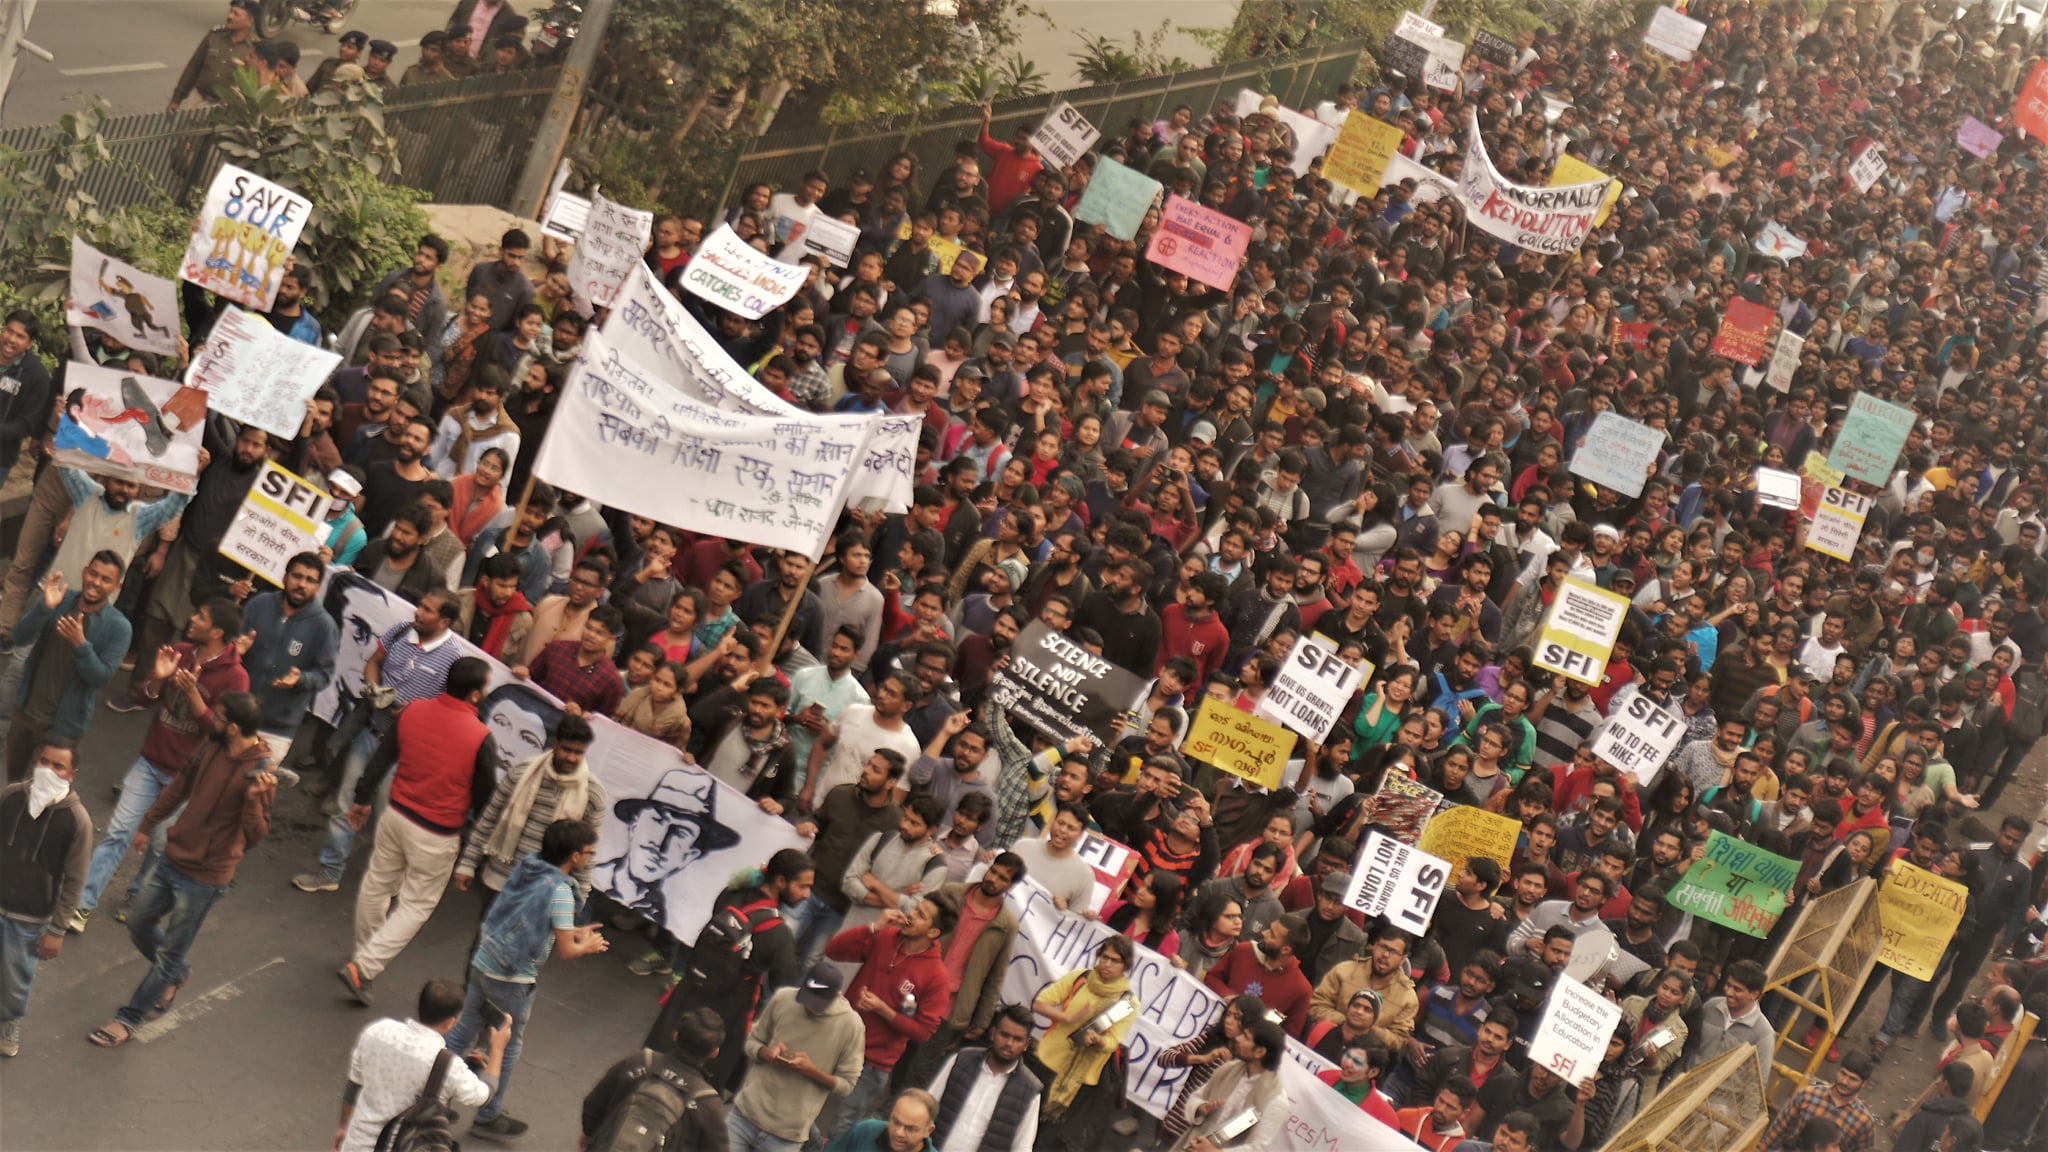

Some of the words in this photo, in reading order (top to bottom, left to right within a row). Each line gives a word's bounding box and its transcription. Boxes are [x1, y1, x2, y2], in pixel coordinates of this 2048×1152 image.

[1035, 130, 1052, 146] NOT
[1060, 107, 1095, 142] SFI
[1866, 149, 1884, 171] SFI
[229, 176, 303, 223] SAVE
[224, 197, 288, 238] OUR
[1194, 222, 1222, 240] EQUAL
[1204, 215, 1240, 233] ACTION
[1188, 244, 1236, 271] REACTION
[689, 268, 744, 302] CATCHES
[752, 272, 788, 297] INDIA
[262, 470, 323, 519] SFI
[1826, 487, 1867, 513] SFI
[1040, 631, 1113, 679] SCIENCE
[1298, 644, 1352, 690] SFI
[1544, 643, 1593, 677] SFI
[1011, 655, 1089, 713] SILENCE
[1049, 663, 1087, 686] NOT
[1267, 685, 1294, 709] NOT
[1291, 700, 1329, 734] LOANS
[1280, 673, 1297, 691] GIVE
[1296, 684, 1307, 697] US
[1306, 692, 1335, 718] GRANTS,
[1628, 697, 1678, 739] SFI
[1193, 740, 1217, 759] SFI
[1608, 722, 1626, 739] NO
[1625, 732, 1640, 749] TO
[1638, 742, 1660, 763] FEE
[1608, 742, 1635, 766] HIKE
[1079, 834, 1117, 868] FI
[1374, 838, 1397, 867] NOT
[1397, 848, 1410, 868] GIVE
[1707, 836, 1757, 873] शिक्षा
[1355, 866, 1385, 910] LOANS
[1389, 867, 1402, 880] US
[1726, 872, 1754, 897] या
[1401, 864, 1444, 925] SFI
[1043, 914, 1108, 970] HIK
[1562, 999, 1602, 1030] Budgetary
[1565, 987, 1595, 1011] Increase
[1597, 1005, 1609, 1019] the
[1553, 1010, 1592, 1039] Allocation
[1592, 1032, 1601, 1044] in
